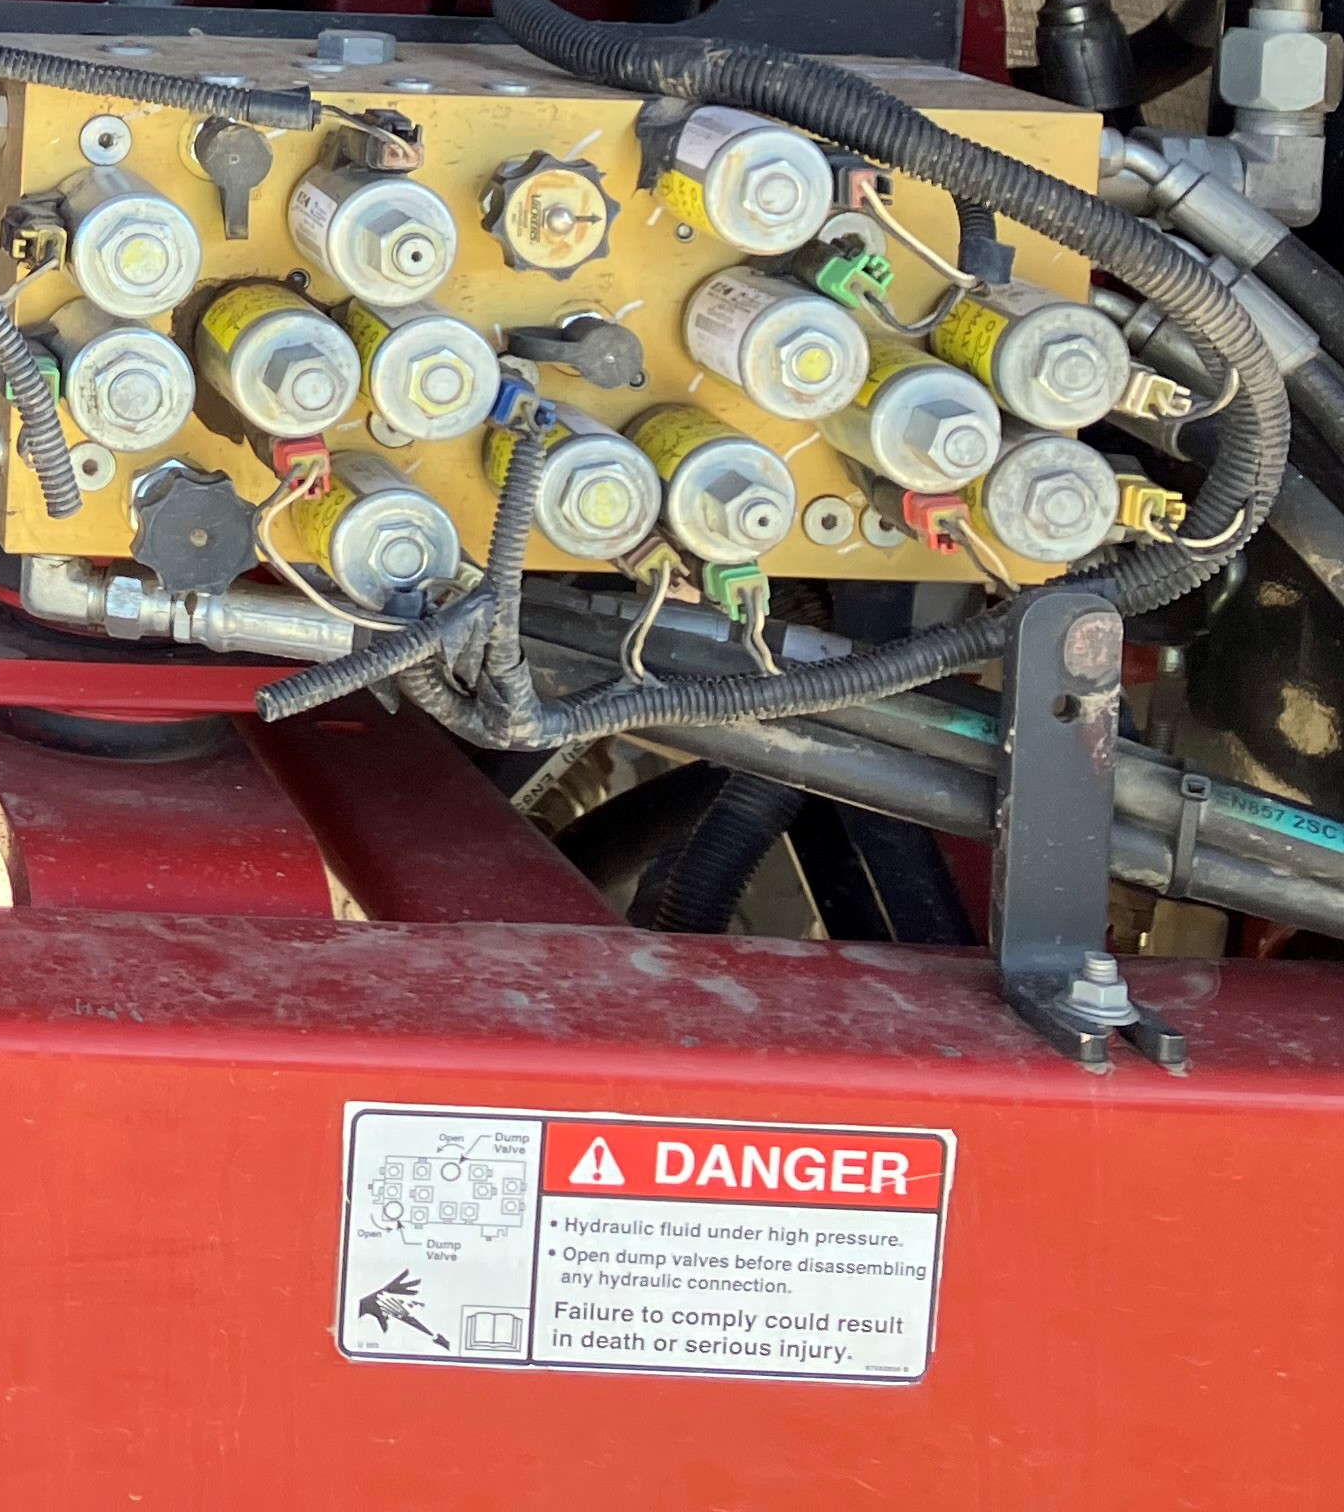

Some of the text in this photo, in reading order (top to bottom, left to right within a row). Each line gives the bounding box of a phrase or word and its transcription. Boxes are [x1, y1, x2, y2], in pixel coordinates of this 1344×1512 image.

[1292, 814, 1338, 840] 2SC
[439, 1133, 464, 1144] Open
[494, 1132, 530, 1145] Dump
[494, 1144, 526, 1155] Valve
[654, 1140, 910, 1196] DANGER
[357, 1229, 383, 1240] Open
[564, 1216, 904, 1248] Hydraulic fluid under high pressure.
[426, 1239, 462, 1252] Dump
[426, 1251, 458, 1262] Valve
[563, 1246, 927, 1281] Open dump valves before disassembling
[561, 1270, 792, 1294] any hydraulic connection.
[554, 1300, 904, 1335] Failure to comply could result
[552, 1329, 853, 1365] in death or serious injury.
